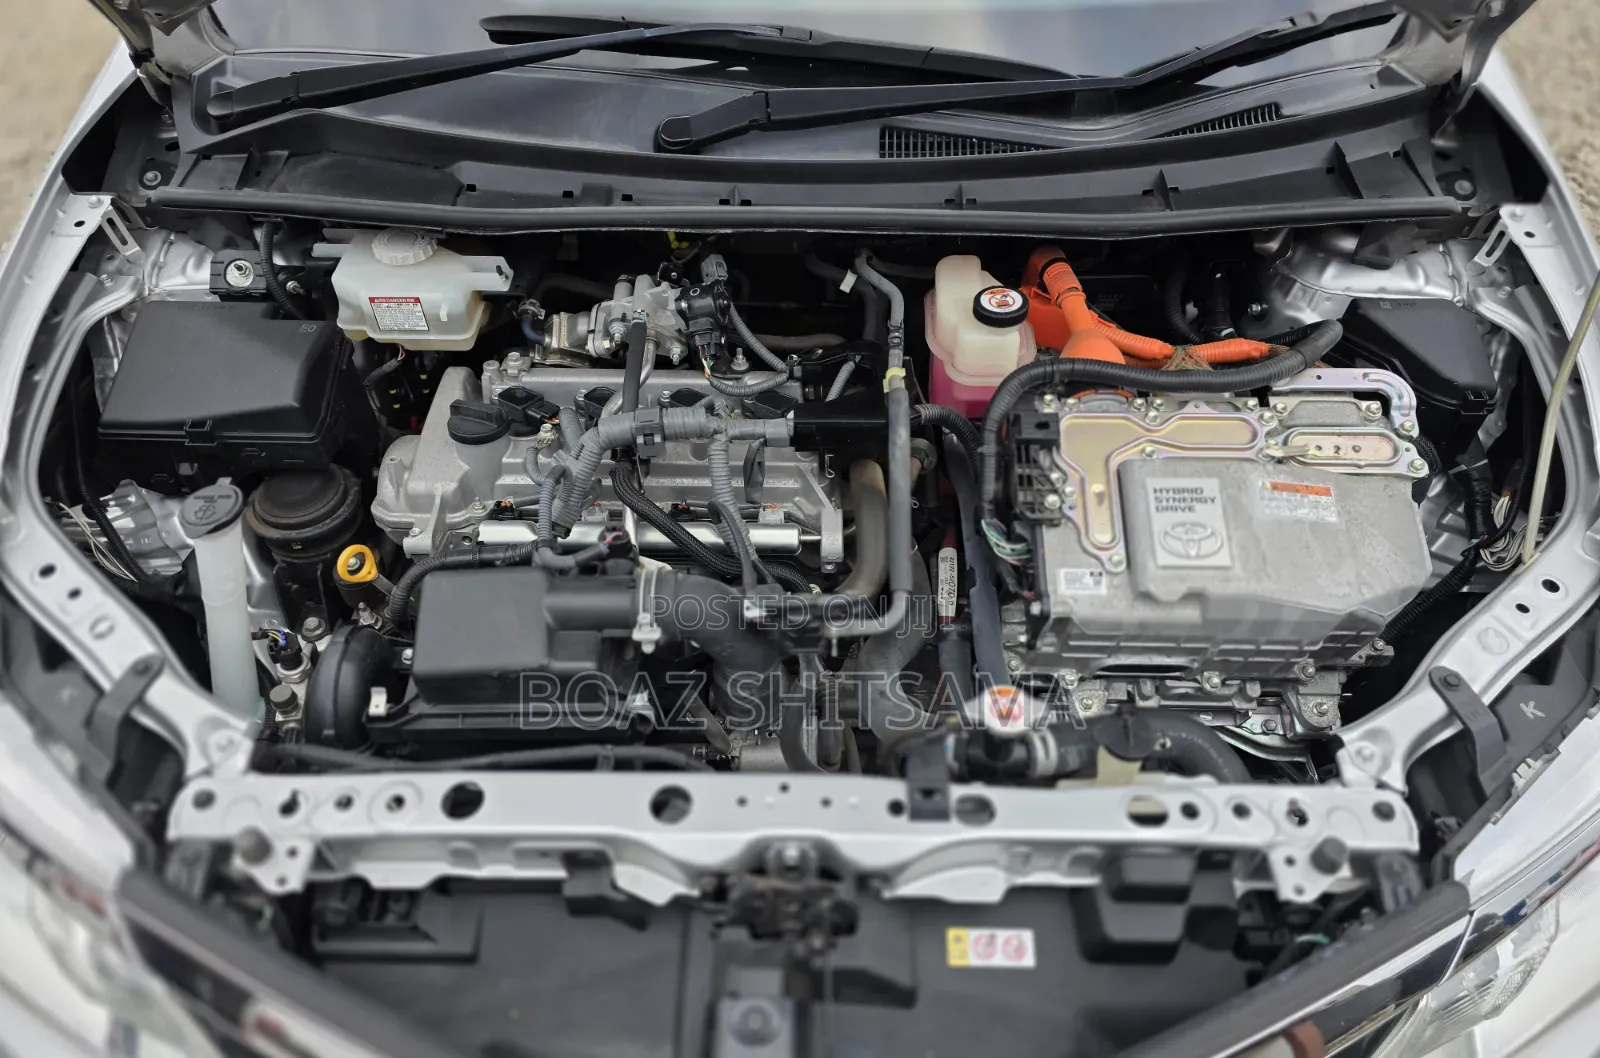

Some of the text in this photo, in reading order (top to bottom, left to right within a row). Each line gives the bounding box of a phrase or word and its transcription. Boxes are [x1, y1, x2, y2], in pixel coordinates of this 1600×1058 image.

[1153, 487, 1204, 496] HYBRID
[1154, 496, 1217, 505] SYNERGY
[1155, 505, 1197, 513] DRIVE
[1519, 700, 1546, 719] K
